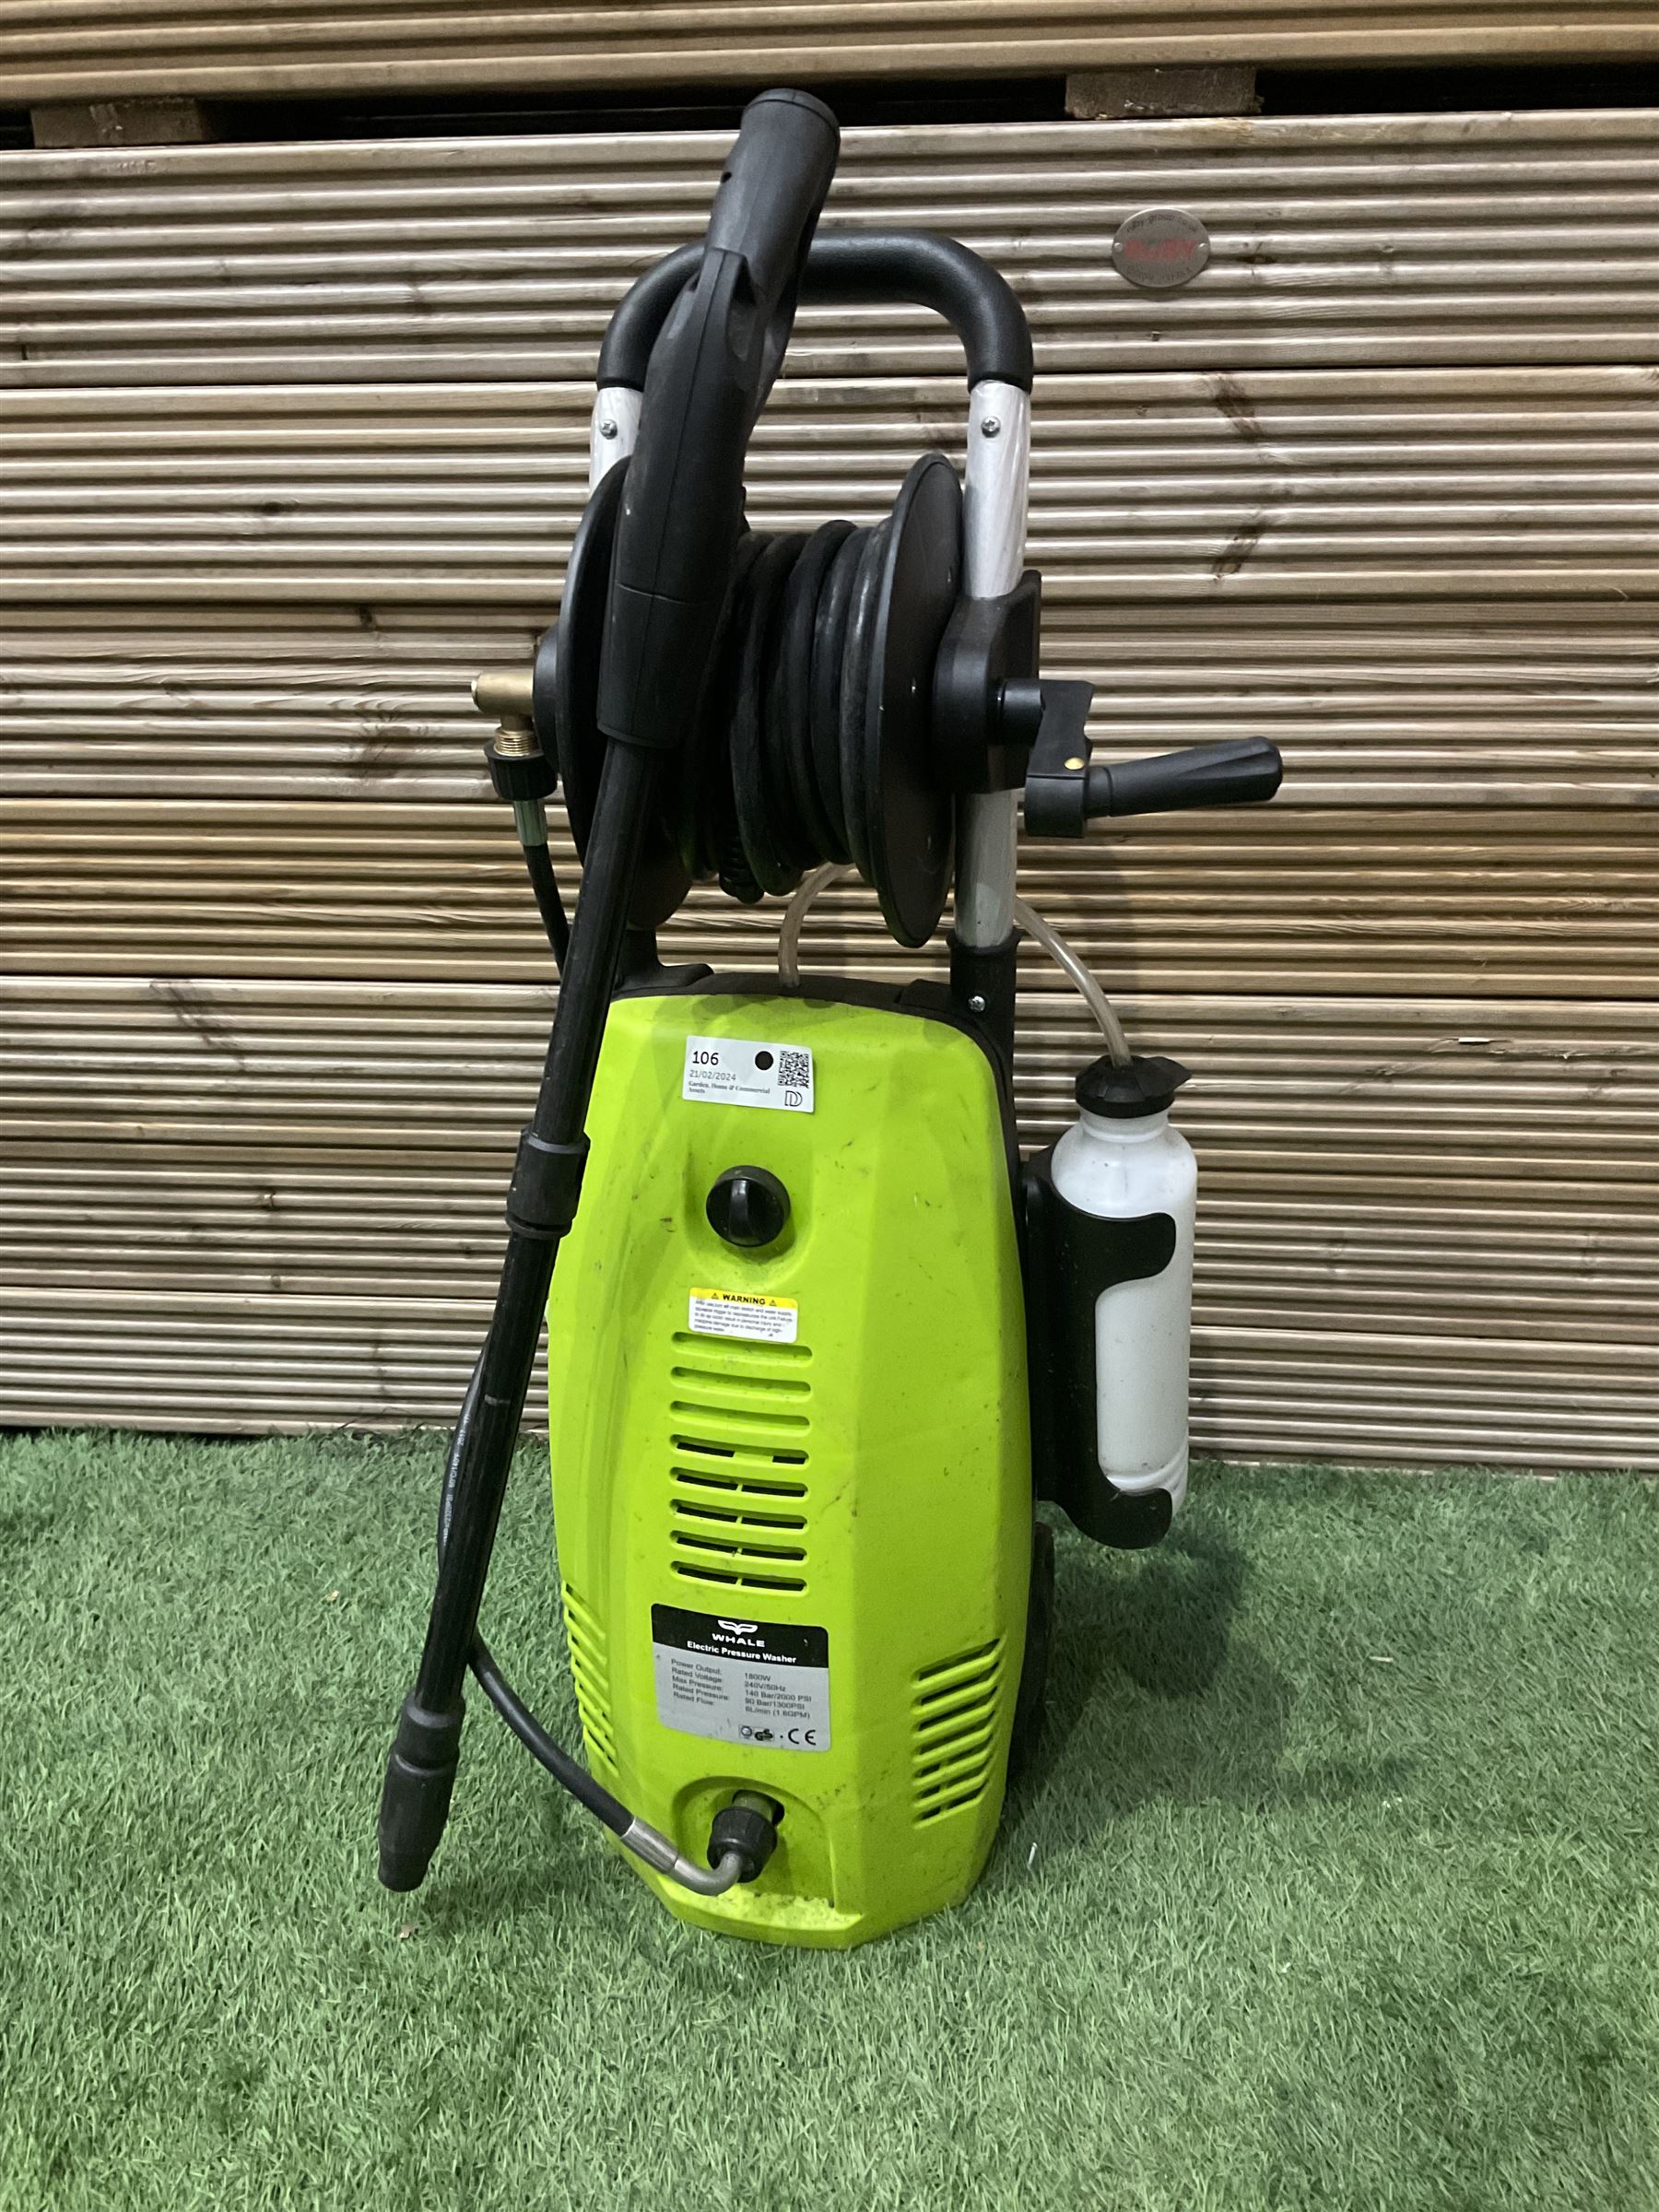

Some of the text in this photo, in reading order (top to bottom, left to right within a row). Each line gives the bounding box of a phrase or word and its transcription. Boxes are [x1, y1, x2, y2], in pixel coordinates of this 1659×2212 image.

[692, 1051, 719, 1065] 106
[689, 1069, 736, 1081] 21/02/2024
[723, 1294, 766, 1305] WARNING
[712, 1633, 765, 1648] WHALE
[687, 1641, 797, 1664] Electric Pressure Washer
[671, 1658, 771, 1682] Power Output: 1800W
[672, 1666, 693, 1677] Rated
[745, 1681, 786, 1691] 240V/50Hz
[672, 1676, 687, 1685] Max
[760, 1691, 795, 1700] Bar/2000
[673, 1683, 694, 1694] Rated
[756, 1699, 805, 1710] Bar/1300PSI
[674, 1691, 695, 1702] Rated
[773, 1709, 810, 1719] (16GPM)
